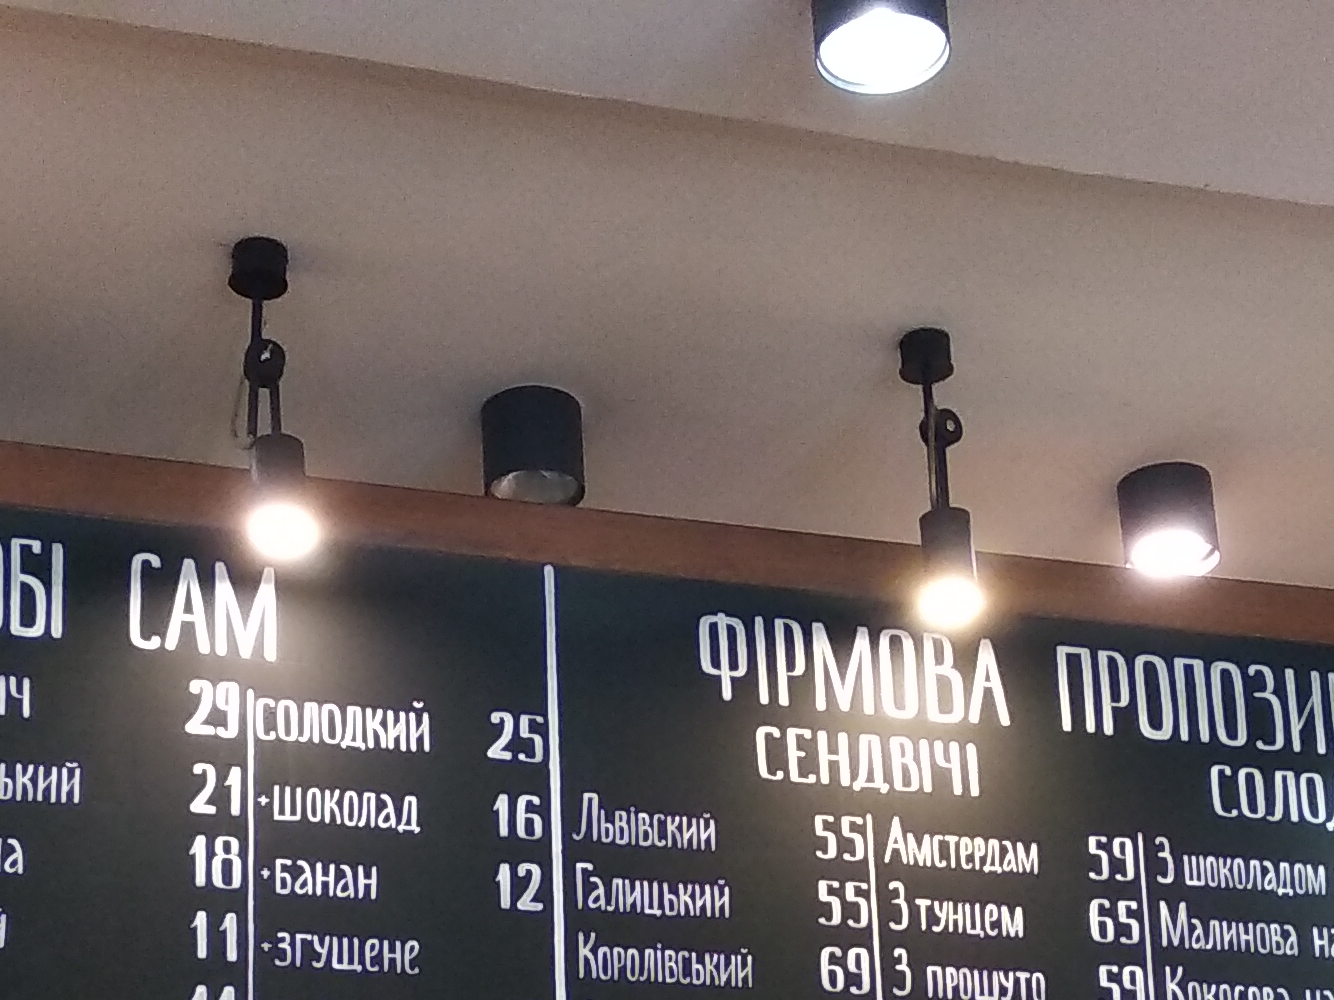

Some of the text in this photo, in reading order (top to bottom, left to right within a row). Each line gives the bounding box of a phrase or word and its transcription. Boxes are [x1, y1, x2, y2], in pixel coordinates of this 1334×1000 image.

[129, 553, 276, 662] САМ
[699, 613, 1010, 726] ФІРМОВА
[185, 679, 240, 738] 29
[487, 712, 544, 763] 25
[756, 726, 979, 797] СЕНДВІЧІ
[190, 763, 241, 816] 21
[493, 794, 542, 840] 16
[815, 815, 864, 861] 55
[189, 835, 242, 889] 18
[884, 816, 1134, 881] Амстердам 59
[1183, 855, 1326, 896] шоколадом
[495, 863, 543, 911] 12
[576, 862, 869, 928] Галицький 55
[190, 911, 237, 962] 11
[915, 898, 1023, 938] тунцем
[1089, 899, 1139, 944] 65
[1159, 900, 1298, 956] Малинова
[578, 931, 870, 994] Королівський 69
